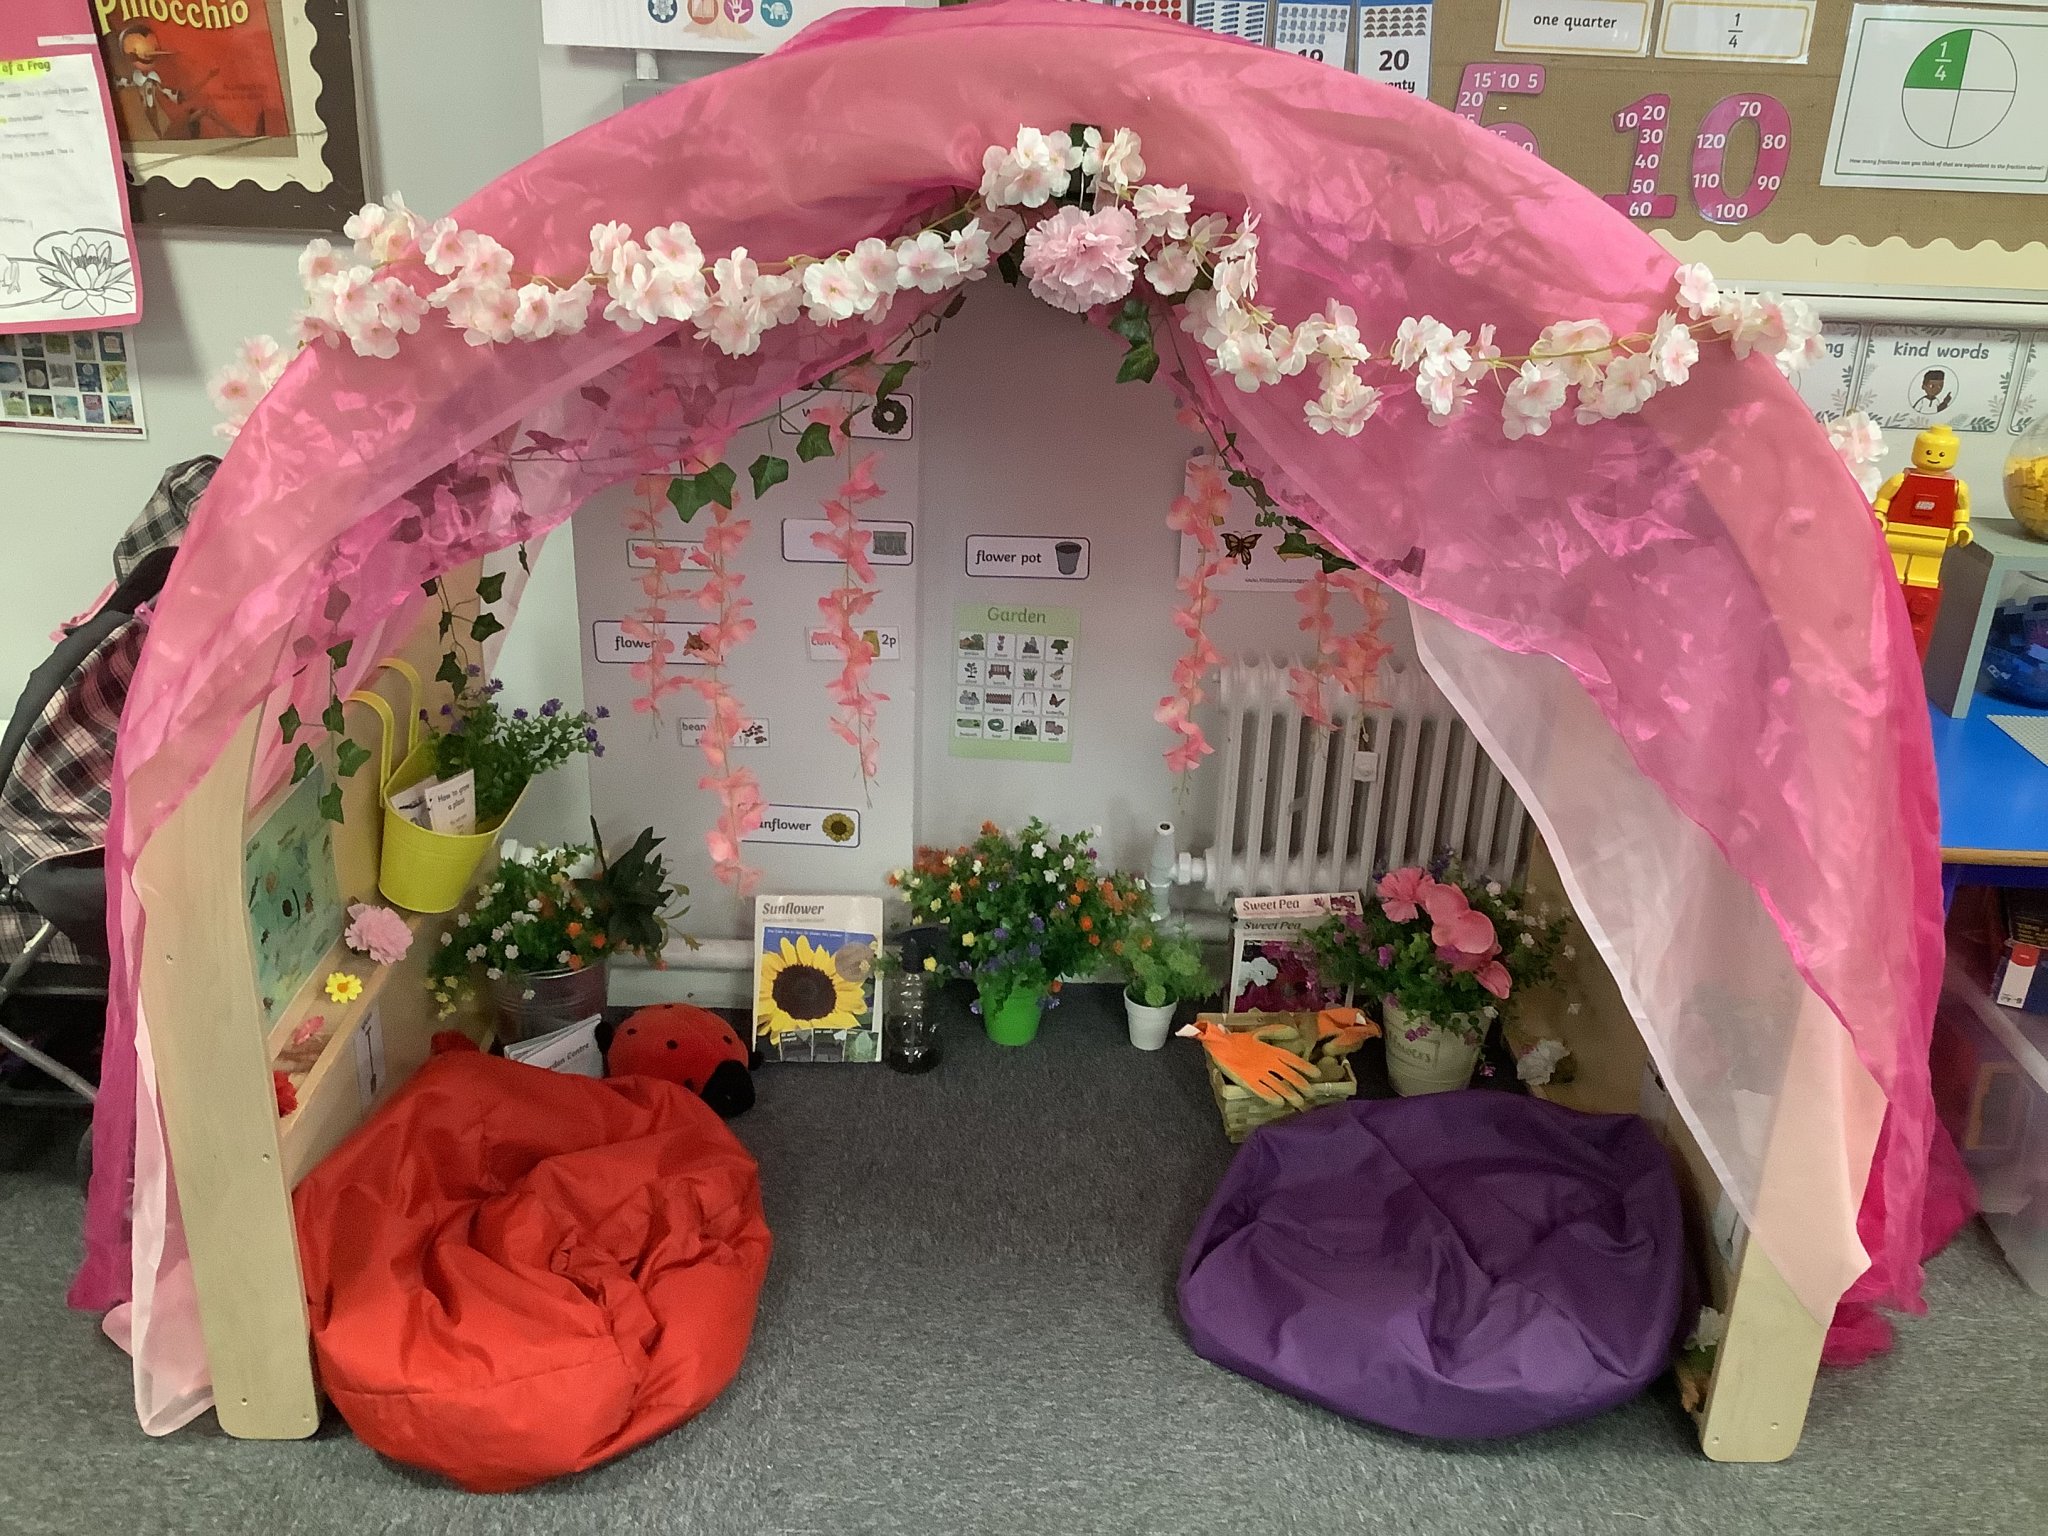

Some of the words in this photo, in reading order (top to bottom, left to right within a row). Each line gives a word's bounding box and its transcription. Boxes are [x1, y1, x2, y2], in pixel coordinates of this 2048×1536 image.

[1533, 15, 1559, 27] one
[1564, 15, 1617, 31] quarter
[1734, 13, 1741, 26] 1
[1728, 34, 1738, 48] 4
[1940, 41, 1948, 58] 1
[17, 64, 24, 72] a
[28, 61, 51, 72] Frog
[1379, 49, 1409, 71] 20
[1474, 72, 1492, 88] 15
[1500, 73, 1520, 88] 10
[1527, 73, 1538, 88] 5
[1934, 65, 1947, 81] 4
[1460, 91, 1483, 107] 20
[1642, 105, 1665, 121] 20
[1739, 101, 1761, 117] 70
[1617, 112, 1638, 128] 10
[1640, 128, 1663, 144] 30
[1697, 134, 1726, 149] 120
[1762, 134, 1786, 149] 80
[1635, 154, 1659, 169] 40
[1632, 179, 1655, 194] 50
[1693, 173, 1719, 188] 110
[1757, 175, 1780, 190] 90
[1629, 201, 1652, 217] 60
[1716, 203, 1748, 218] 100
[1893, 341, 1931, 357] kind
[1936, 342, 1990, 360] words
[976, 549, 1017, 565] flower
[1021, 552, 1042, 566] pot
[987, 606, 1047, 625] Garden
[881, 634, 897, 648] 2p
[762, 902, 825, 915] Sunflower
[1243, 900, 1276, 912] Sweet
[1279, 899, 1300, 909] Pea
[1243, 921, 1279, 930] Sweet
[1280, 921, 1301, 930] Pea
[567, 1043, 589, 1061] Centre
